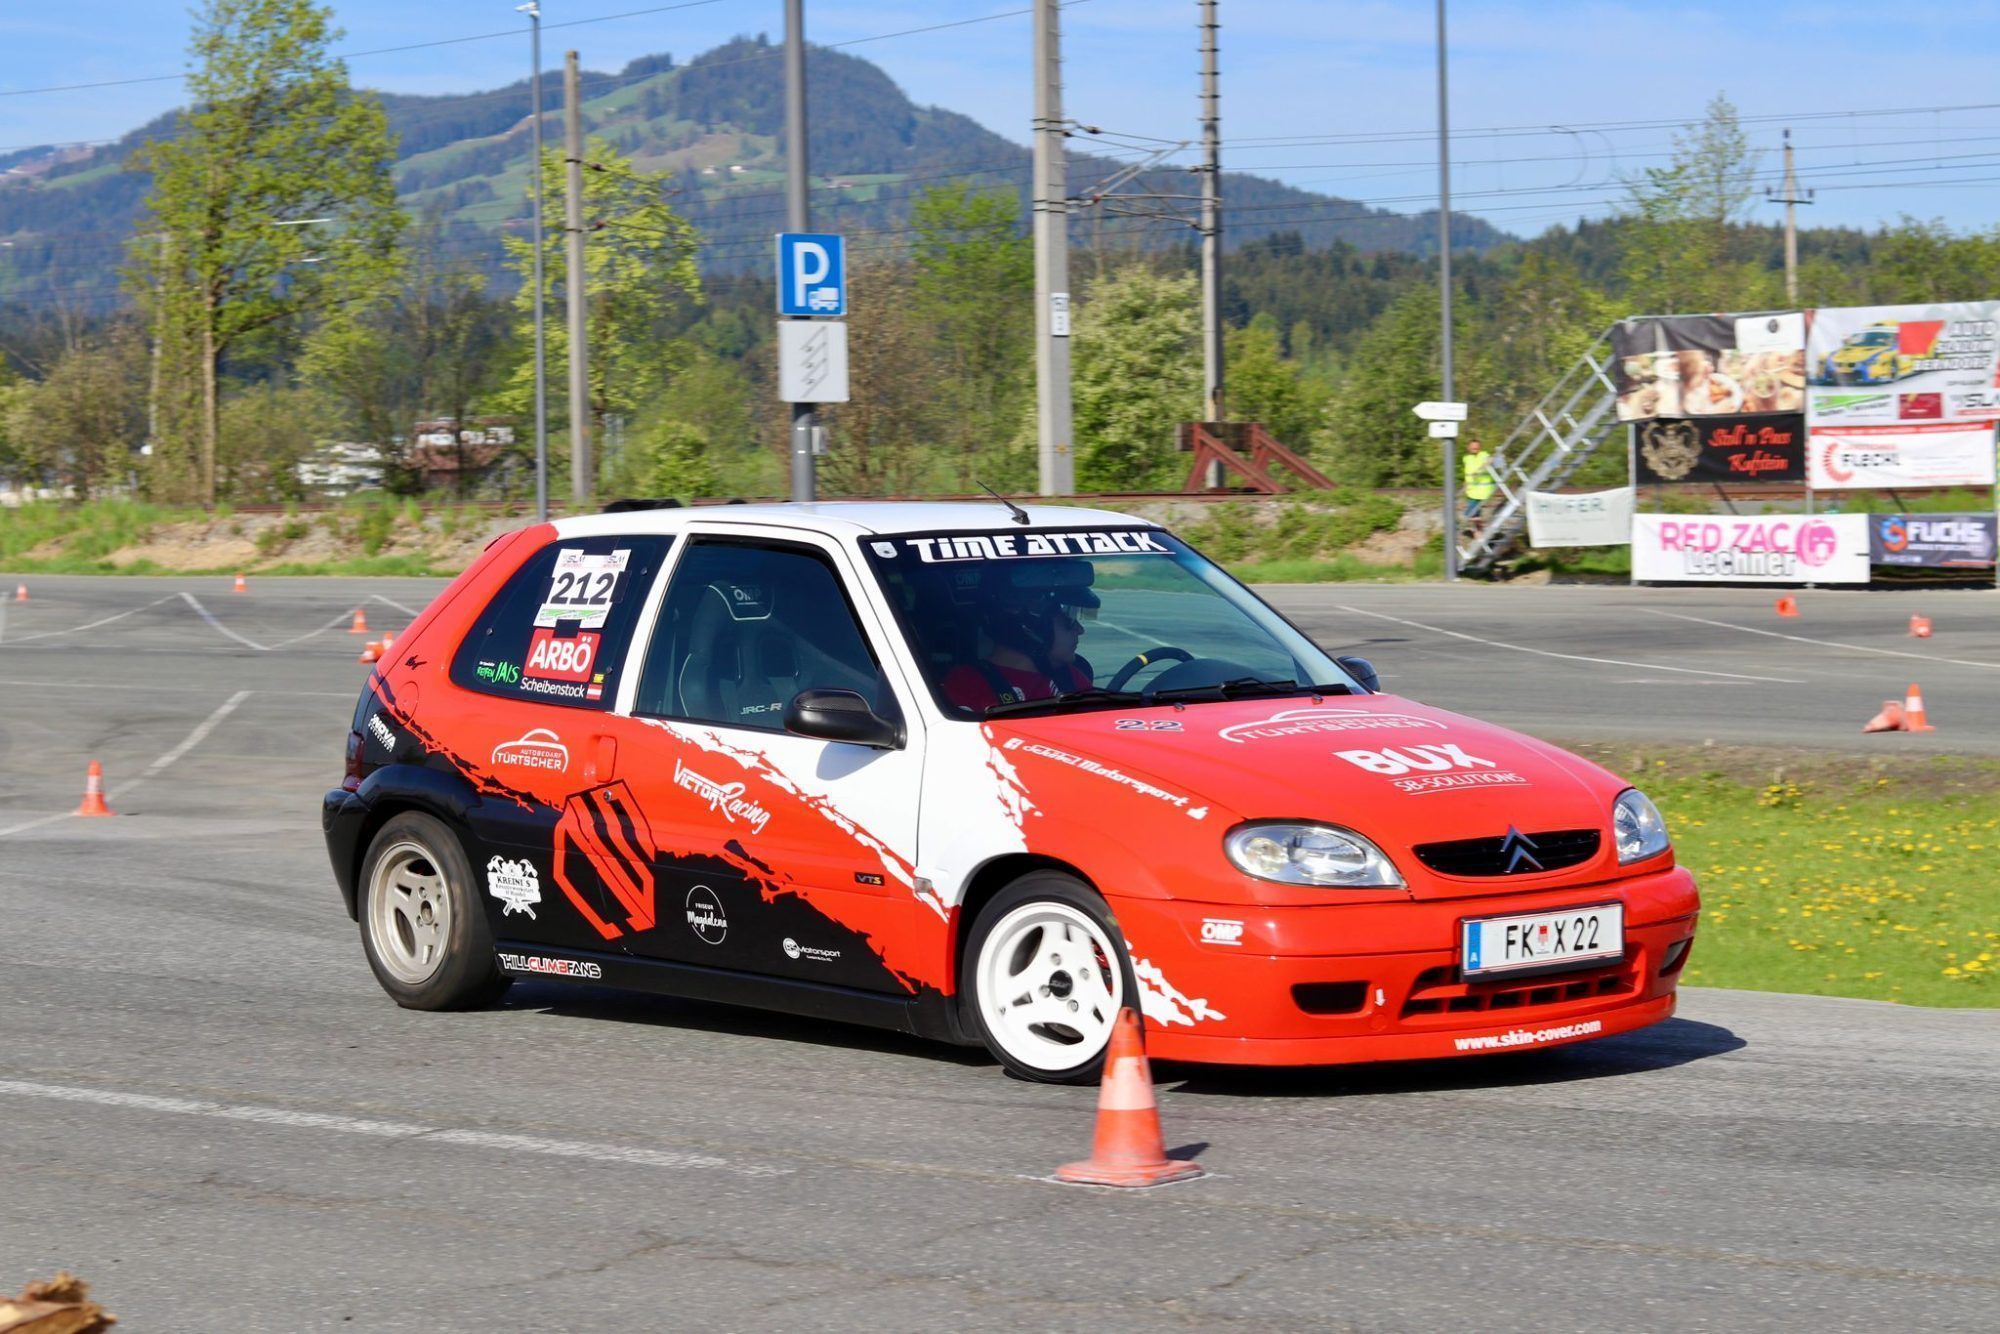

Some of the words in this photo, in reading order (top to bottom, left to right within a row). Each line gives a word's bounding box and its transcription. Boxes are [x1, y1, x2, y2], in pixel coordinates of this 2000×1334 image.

[793, 242, 829, 306] P
[1660, 522, 1721, 551] RED
[1733, 523, 1791, 552] ZAC
[1907, 522, 1985, 542] FUCHS
[1685, 545, 1797, 576] Lechner
[550, 572, 615, 605] 212
[529, 636, 592, 673] ARBÖ
[520, 676, 585, 698] Scheibenstock
[1115, 719, 1185, 732] 22
[497, 752, 562, 770] TÜRTSCHER
[520, 749, 562, 758] AUTOBEDARF
[1332, 744, 1497, 775] BUX
[1393, 772, 1527, 792] SB-SOLUTIONS
[856, 874, 882, 885] VTS
[686, 911, 728, 933] Magdalena
[1201, 922, 1244, 941] OMP
[1505, 924, 1534, 959] FK
[1554, 920, 1566, 953] X
[1573, 916, 1599, 951] 22
[498, 954, 601, 979] HILLCLIMBFANS
[1469, 952, 1478, 962] A
[1454, 1020, 1602, 1050] www.skin-cover.com
